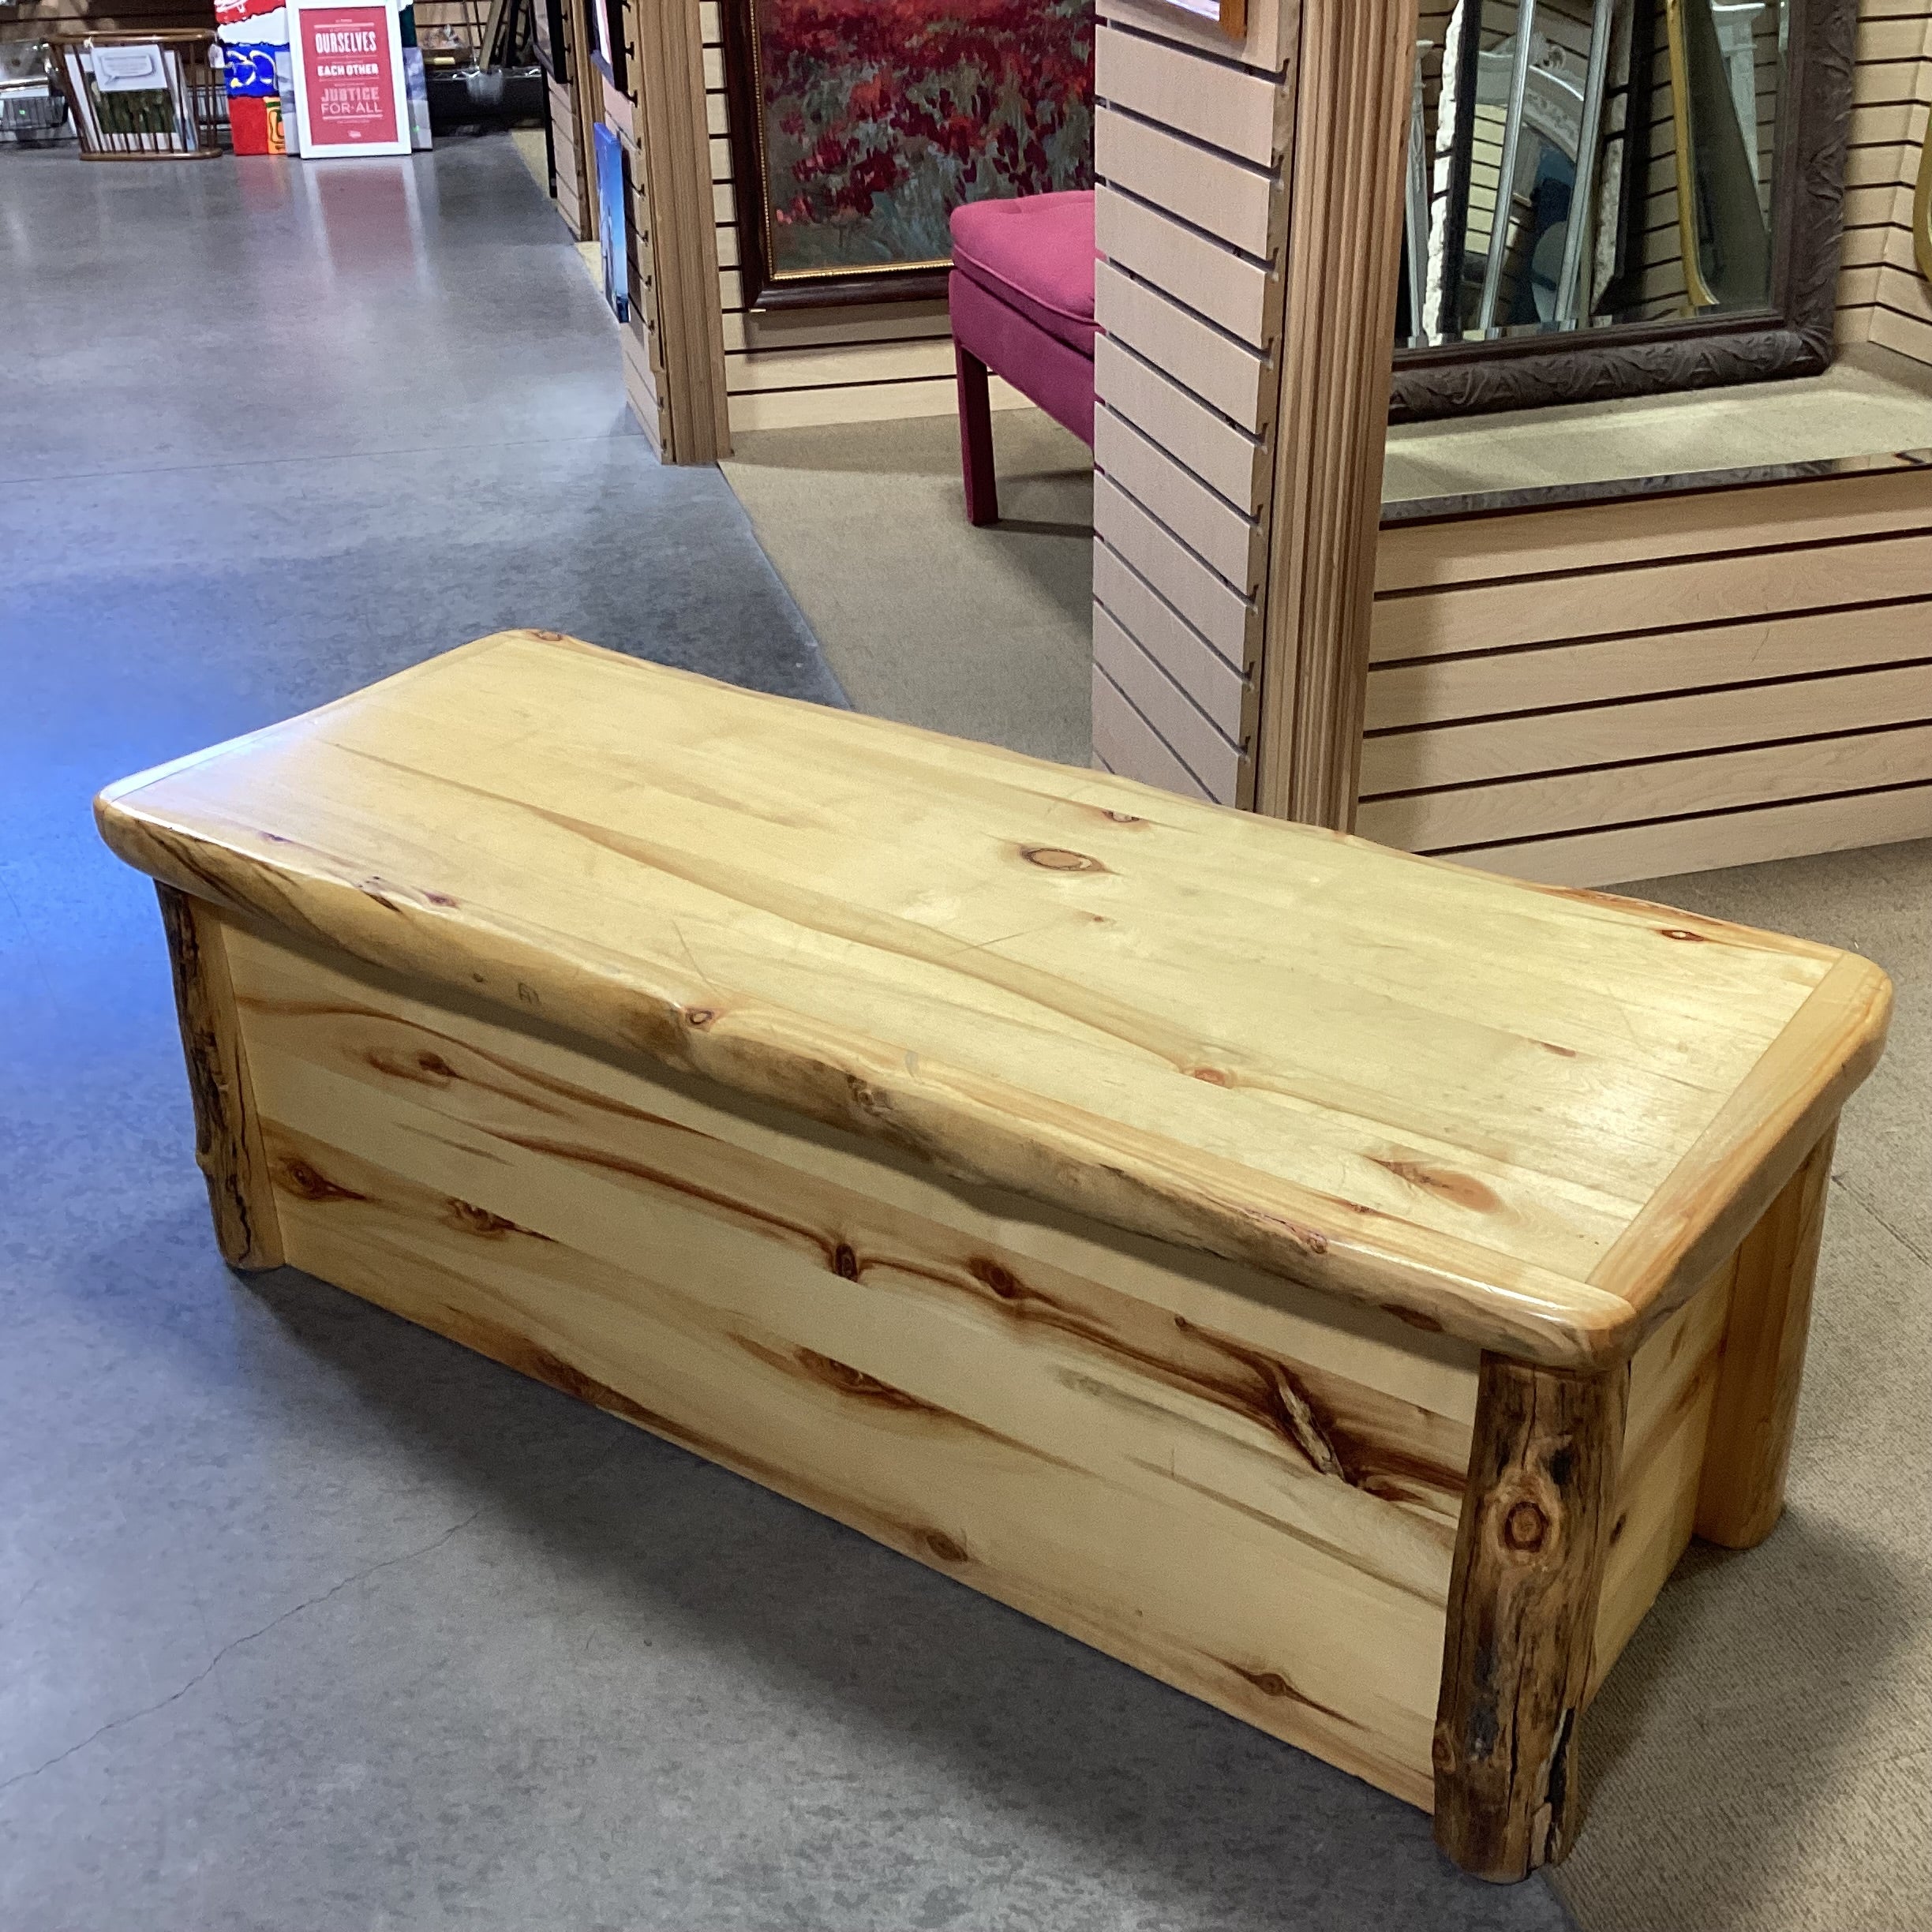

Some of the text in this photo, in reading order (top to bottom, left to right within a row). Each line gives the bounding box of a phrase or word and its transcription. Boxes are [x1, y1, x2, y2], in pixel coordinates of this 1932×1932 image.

[316, 32, 377, 53] OURSELVES
[317, 63, 379, 76] EACH OTHER
[321, 87, 379, 102] JUSTICE
[321, 102, 383, 114] FOR ALL
